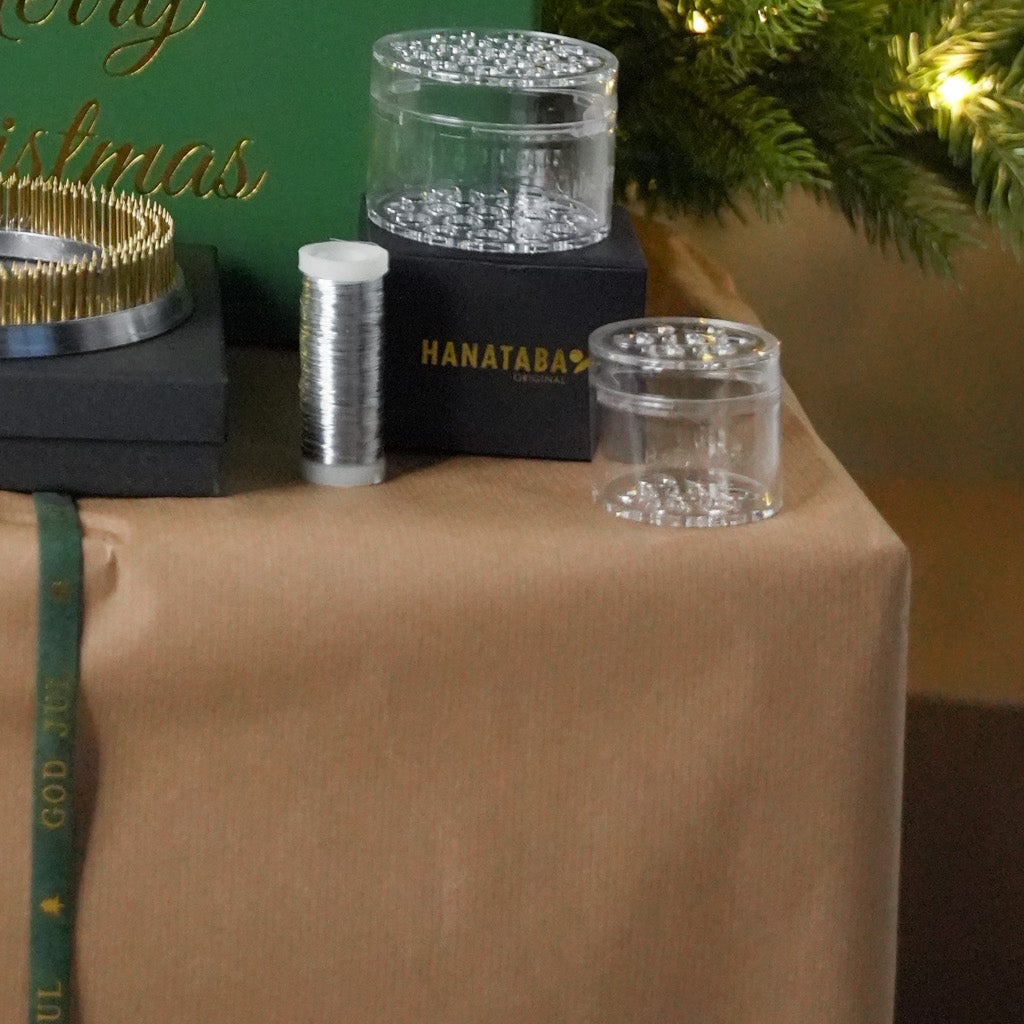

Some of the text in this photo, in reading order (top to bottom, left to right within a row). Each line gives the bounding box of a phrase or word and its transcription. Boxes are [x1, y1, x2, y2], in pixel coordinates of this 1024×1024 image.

[421, 338, 568, 374] HANATABA
[41, 759, 68, 829] GOD
[37, 979, 64, 1024] UL
